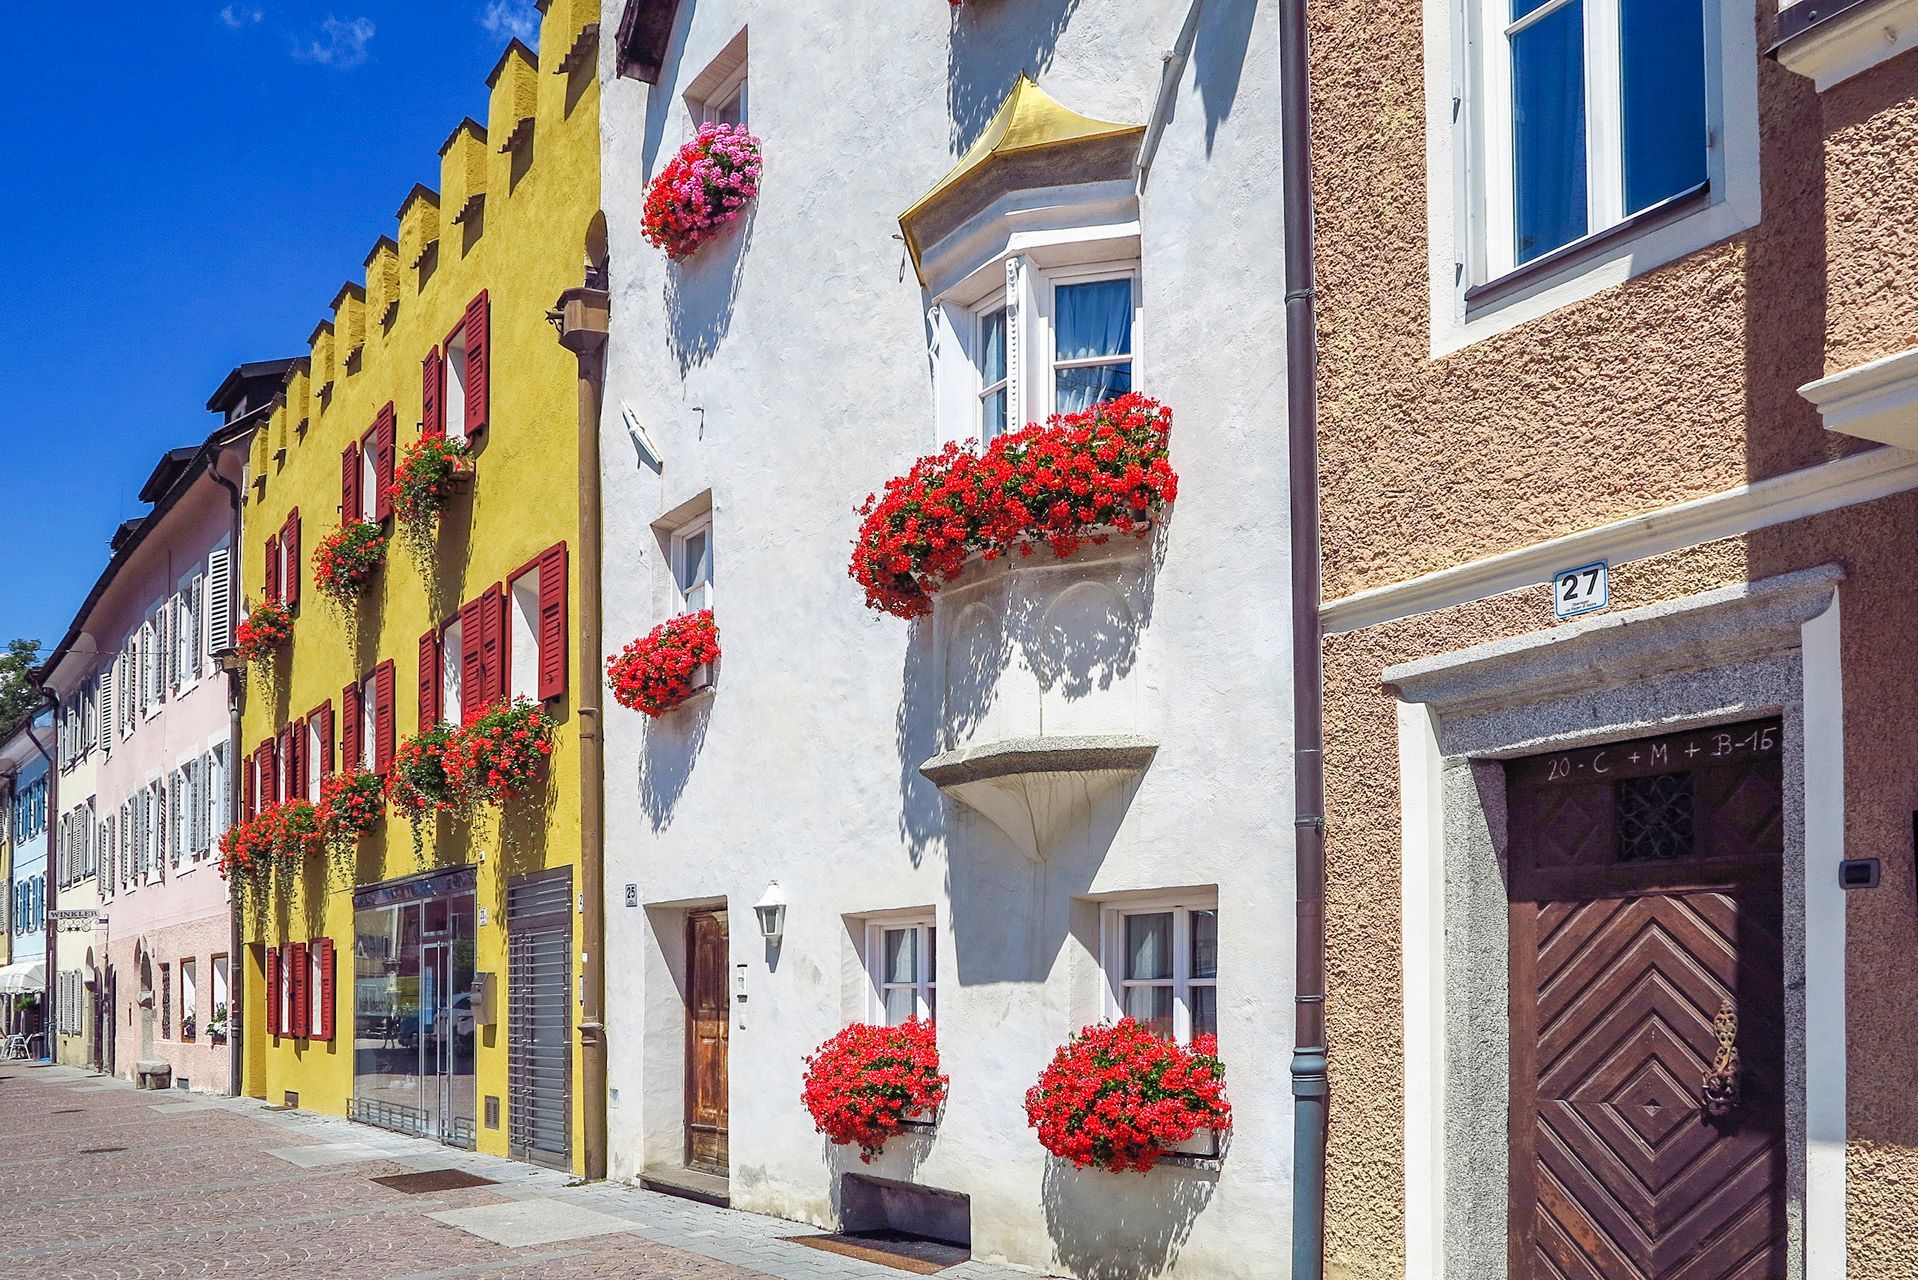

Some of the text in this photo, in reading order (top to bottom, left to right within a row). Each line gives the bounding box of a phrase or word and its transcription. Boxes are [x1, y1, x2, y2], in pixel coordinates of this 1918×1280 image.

[1561, 568, 1599, 601] 27
[1548, 757, 1571, 781] 20
[1650, 743, 1668, 766] M
[626, 886, 636, 899] 25
